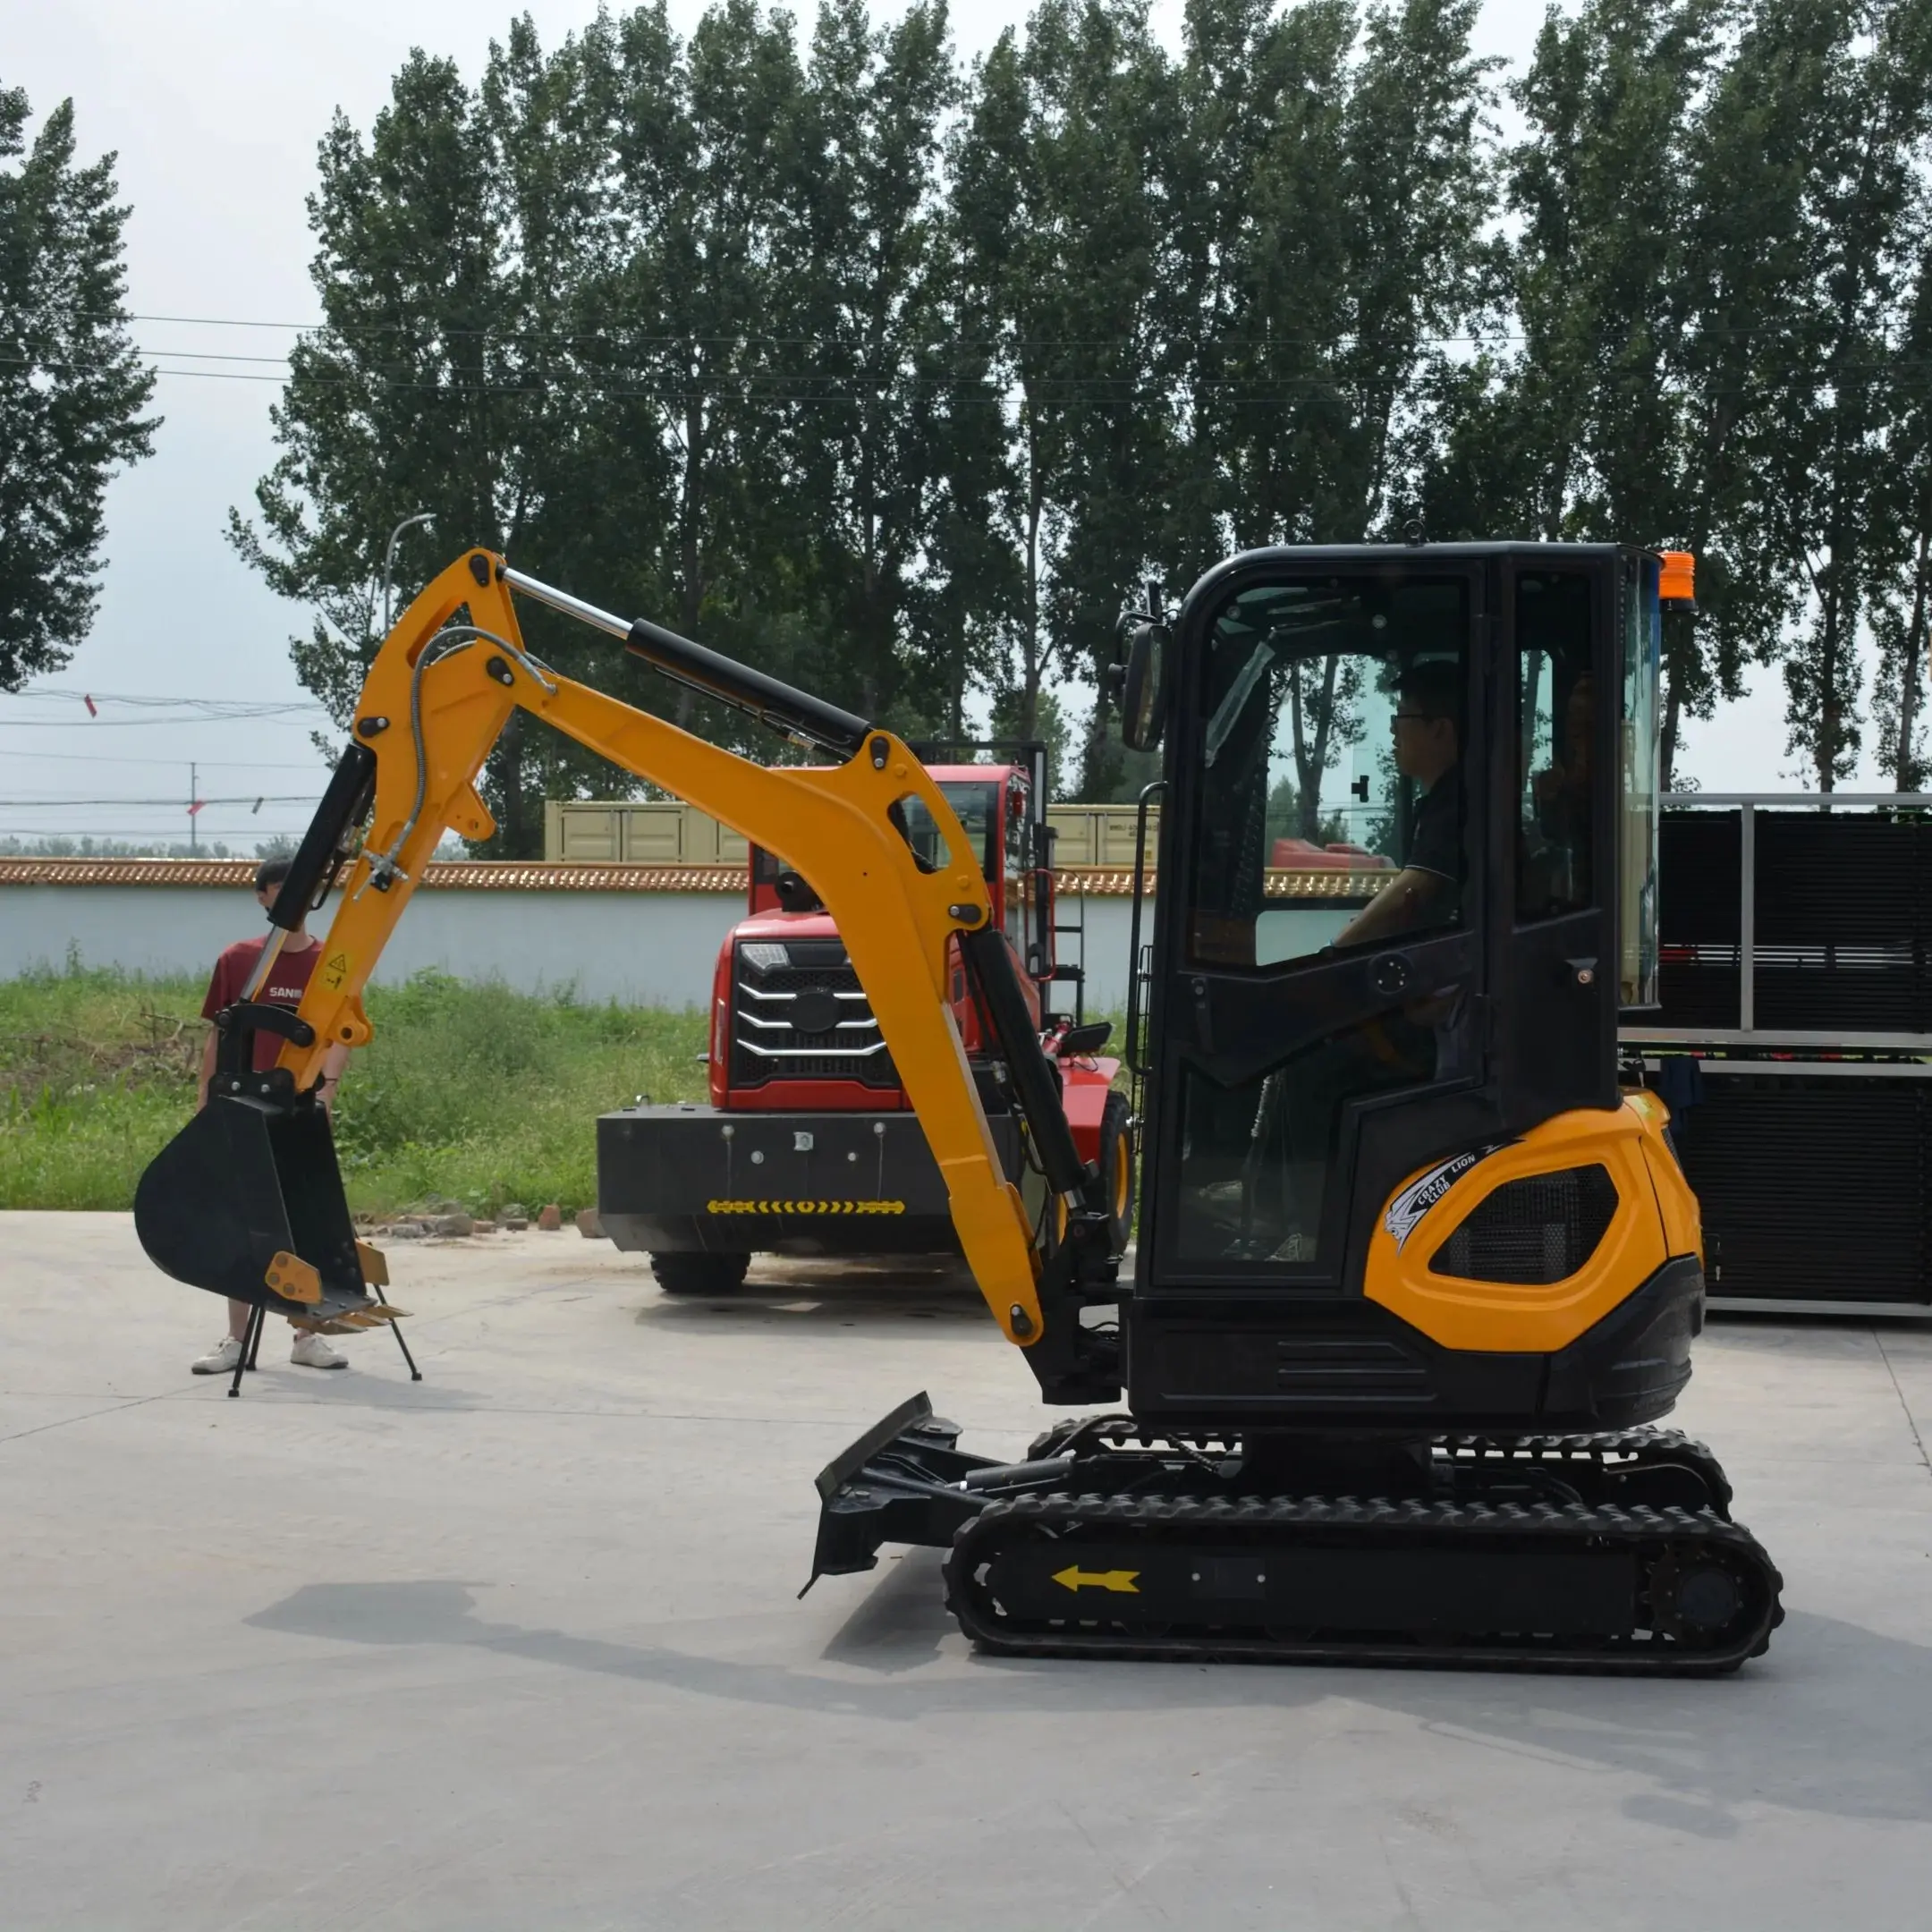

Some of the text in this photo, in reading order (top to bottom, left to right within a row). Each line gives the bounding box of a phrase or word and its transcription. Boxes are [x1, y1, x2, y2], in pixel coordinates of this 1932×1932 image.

[1452, 1155, 1476, 1174] LION
[1418, 1174, 1446, 1205] CRAZY
[1428, 1182, 1451, 1204] CLUB
